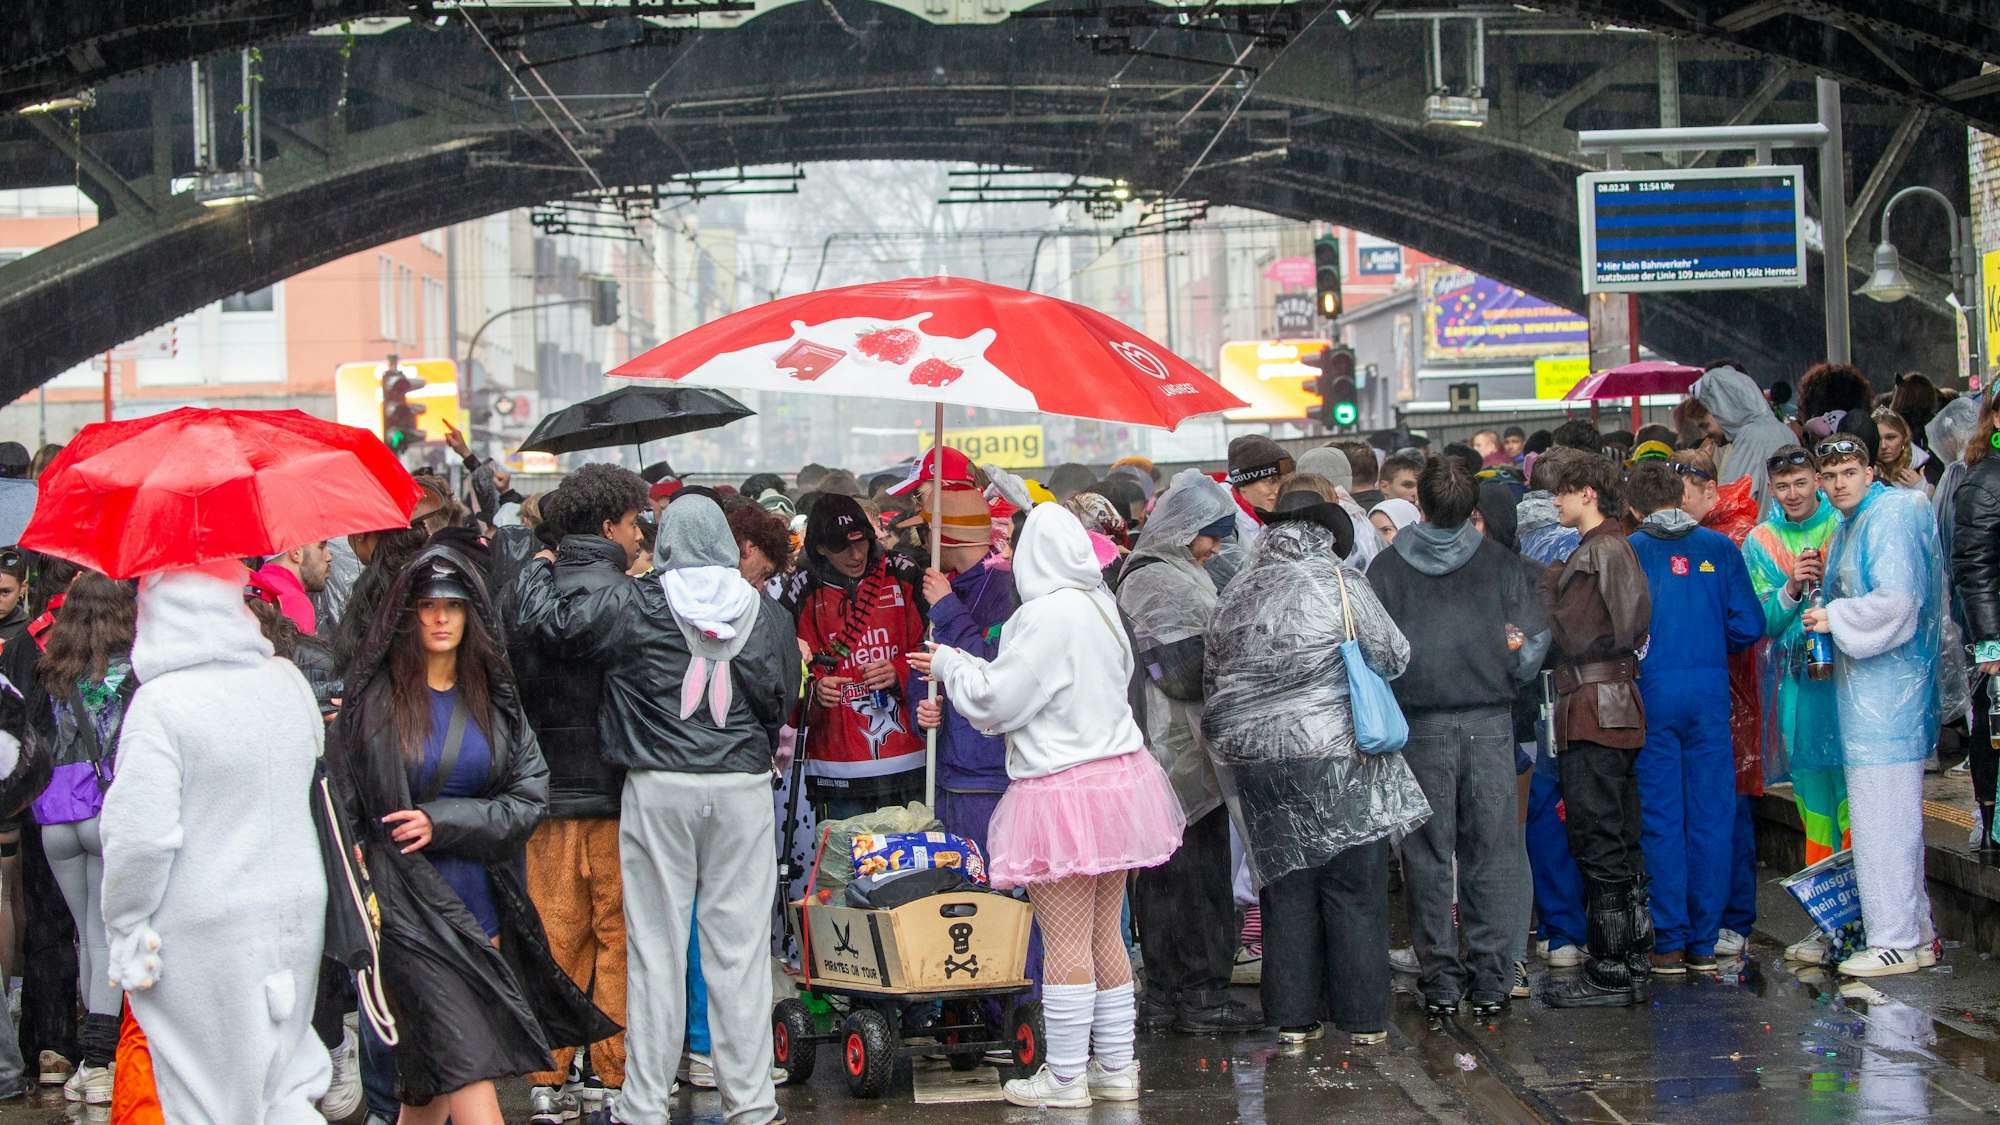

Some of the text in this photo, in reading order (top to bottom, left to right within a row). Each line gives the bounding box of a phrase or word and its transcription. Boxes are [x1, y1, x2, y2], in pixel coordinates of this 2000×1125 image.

[1639, 182, 1660, 191] 11:54
[1660, 181, 1675, 190] Uhr
[1603, 258, 1693, 271] Hier kein Bahnverkehr
[1641, 271, 1655, 281] der
[1656, 270, 1676, 280] Linie
[1678, 270, 1693, 279] 109
[1694, 268, 1731, 279] zwischen
[1732, 268, 1745, 278] (H)
[1746, 267, 1763, 277] Sülz
[1987, 284, 2000, 334] K
[1809, 887, 1860, 916] mein gro
[824, 959, 849, 975] PIRATES
[861, 966, 877, 980] TOUR
